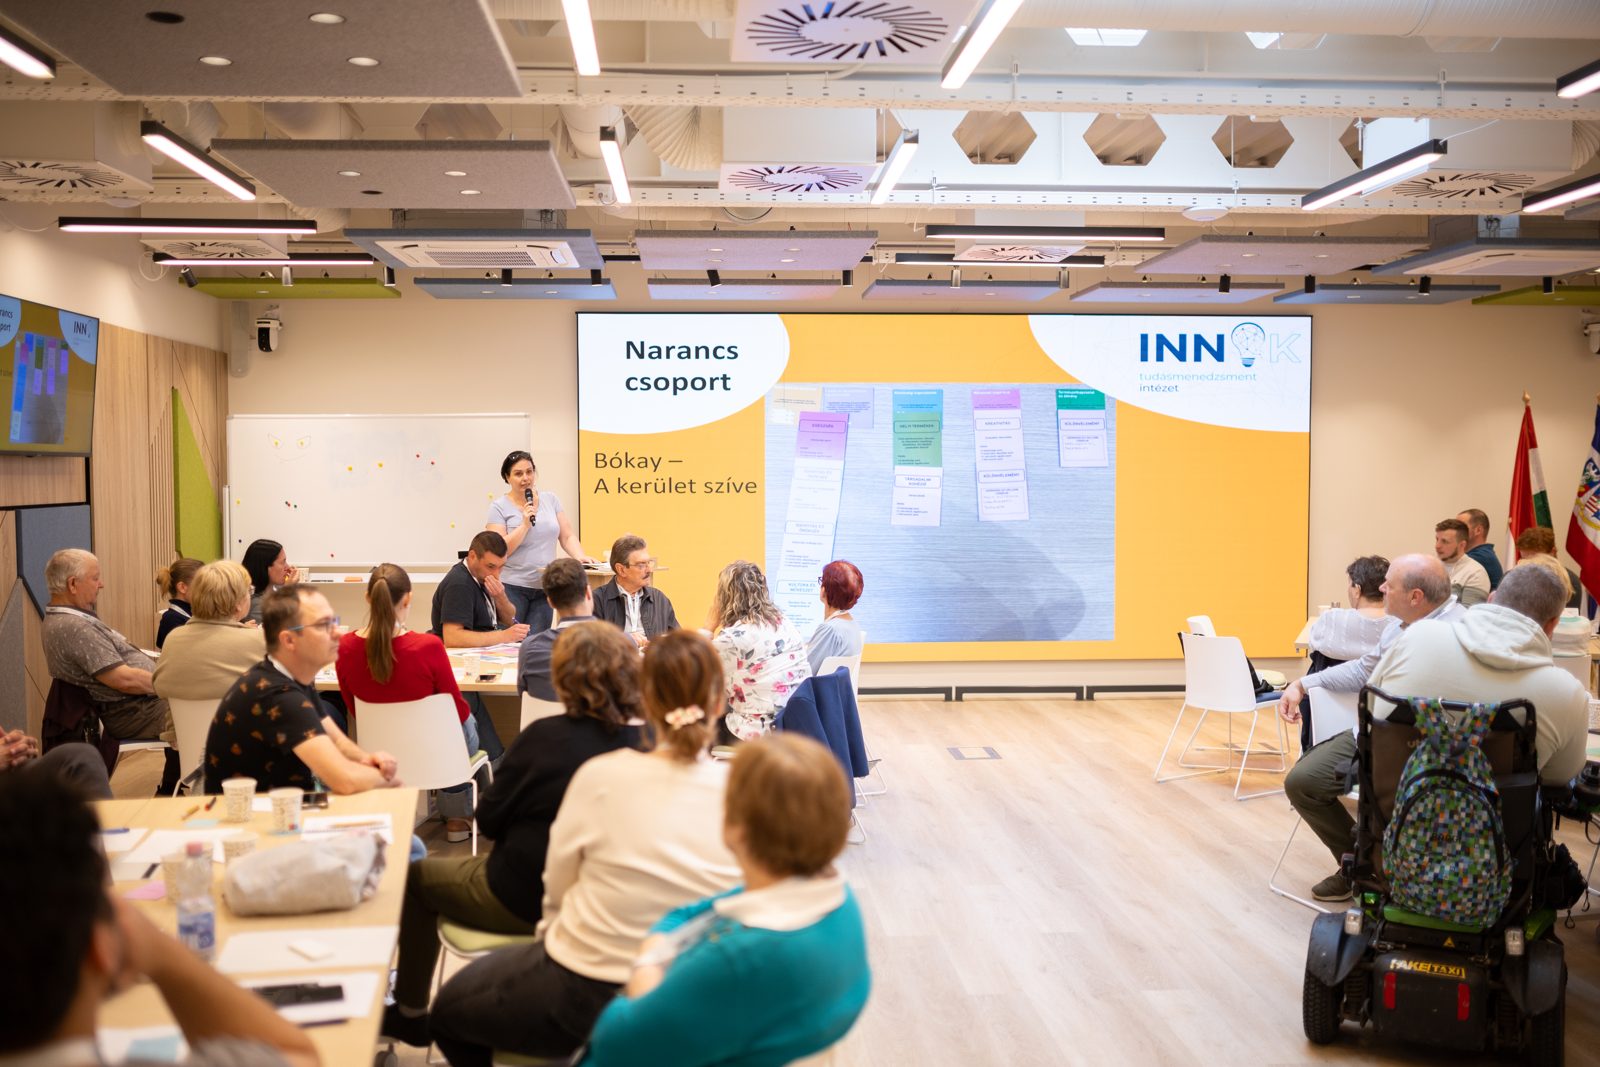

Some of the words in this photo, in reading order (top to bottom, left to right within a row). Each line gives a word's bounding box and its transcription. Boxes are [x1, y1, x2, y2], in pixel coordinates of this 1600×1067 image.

[0, 309, 13, 319] rancs
[626, 341, 739, 360] Narancs
[625, 373, 731, 395] csoport
[1139, 372, 1257, 381] tudásmenedzsment
[1139, 384, 1179, 393] intézet
[594, 452, 662, 472] Bókay
[594, 478, 610, 494] A
[617, 477, 696, 494] kerület
[704, 477, 758, 494] szíve
